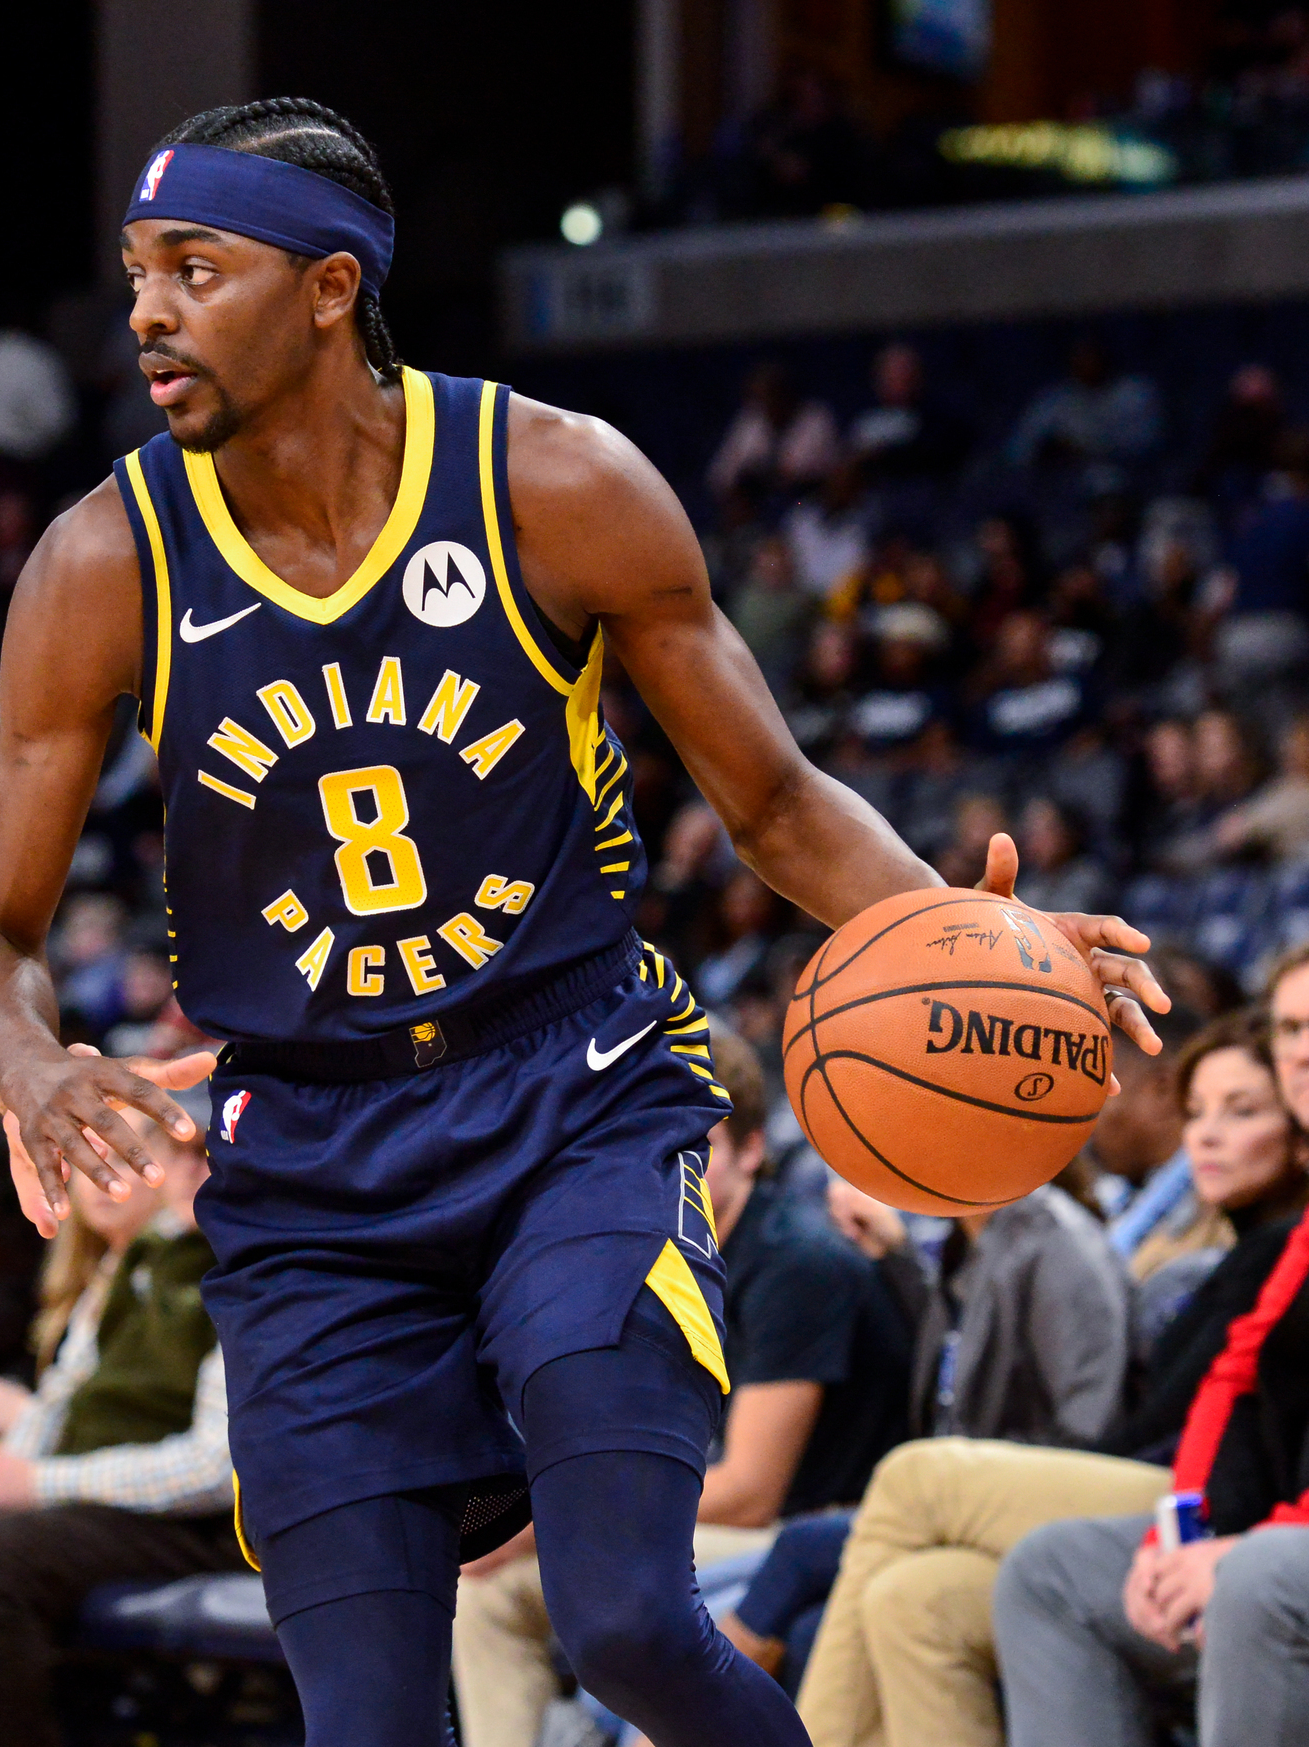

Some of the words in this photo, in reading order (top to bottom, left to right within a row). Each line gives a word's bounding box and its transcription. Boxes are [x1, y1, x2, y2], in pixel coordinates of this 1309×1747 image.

[197, 656, 526, 810] INDIANA
[318, 764, 428, 916] 8
[261, 873, 535, 996] PACERS
